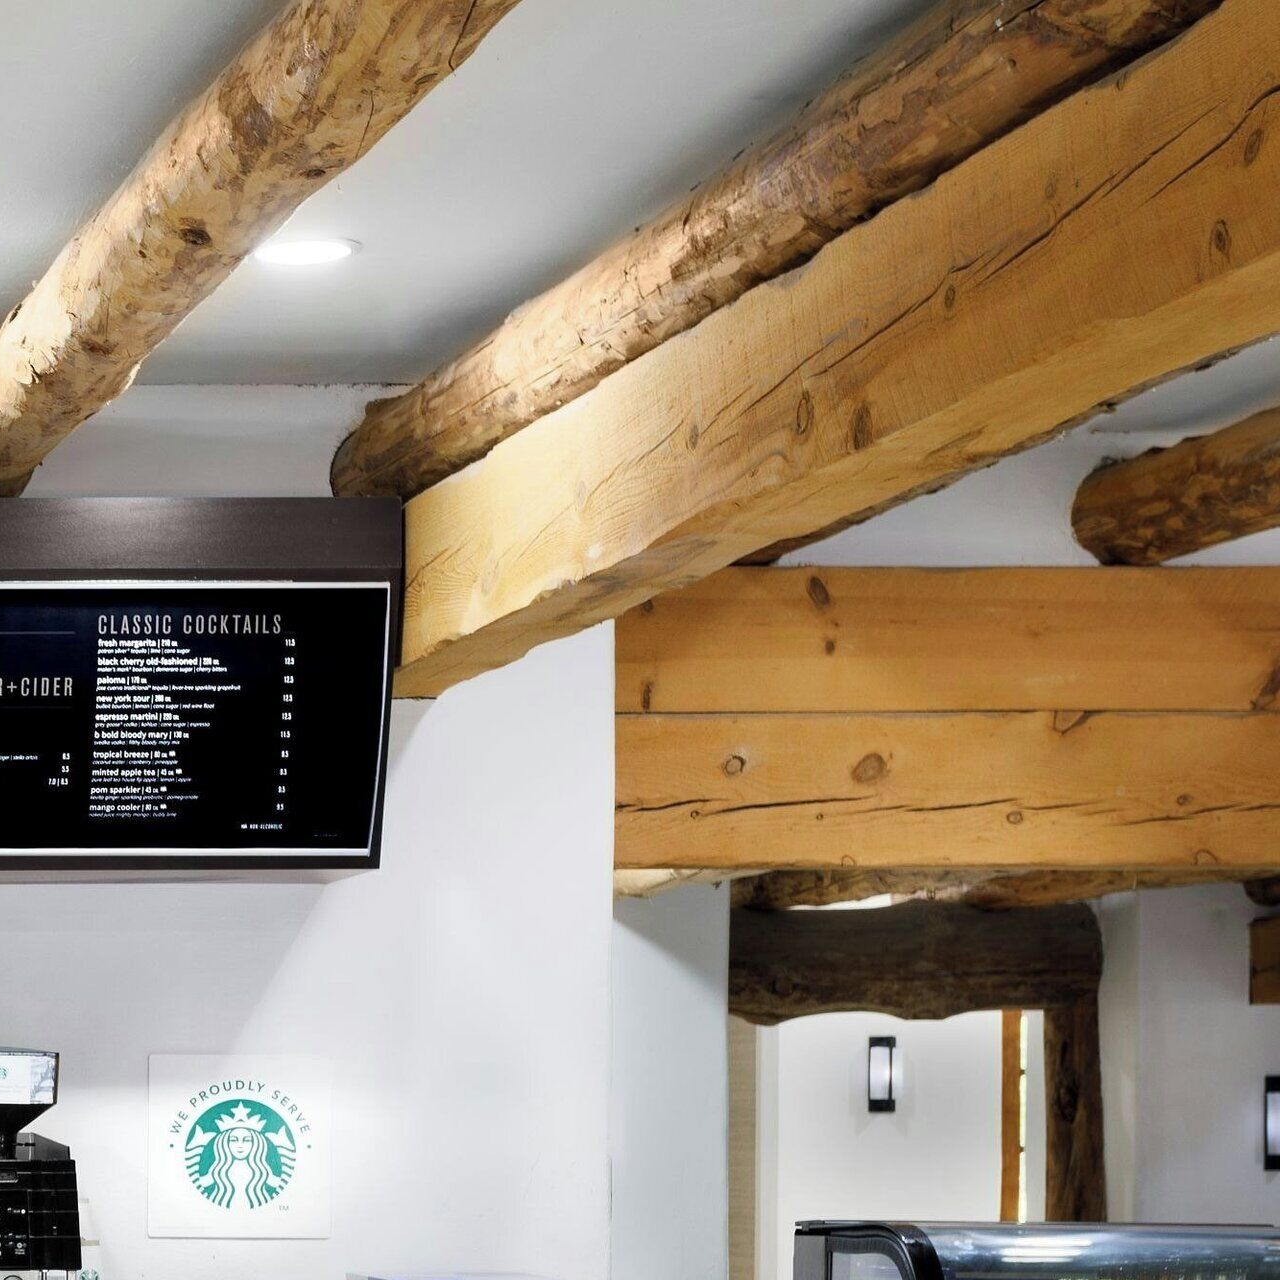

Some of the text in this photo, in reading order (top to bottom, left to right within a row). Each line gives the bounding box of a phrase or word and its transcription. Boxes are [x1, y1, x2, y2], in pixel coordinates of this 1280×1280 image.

[98, 615, 280, 634] CLASSIC COCKTAILS
[94, 711, 159, 723] espresso martini
[100, 730, 119, 739] bold
[119, 730, 147, 741] bloody
[147, 731, 169, 741] mary
[92, 750, 150, 760] tropical breeze
[91, 768, 156, 779] minted apple tea
[90, 785, 141, 796] pom sparkler
[89, 802, 141, 813] mango cooler
[170, 1080, 312, 1135] WE PROUDLY SERVE
